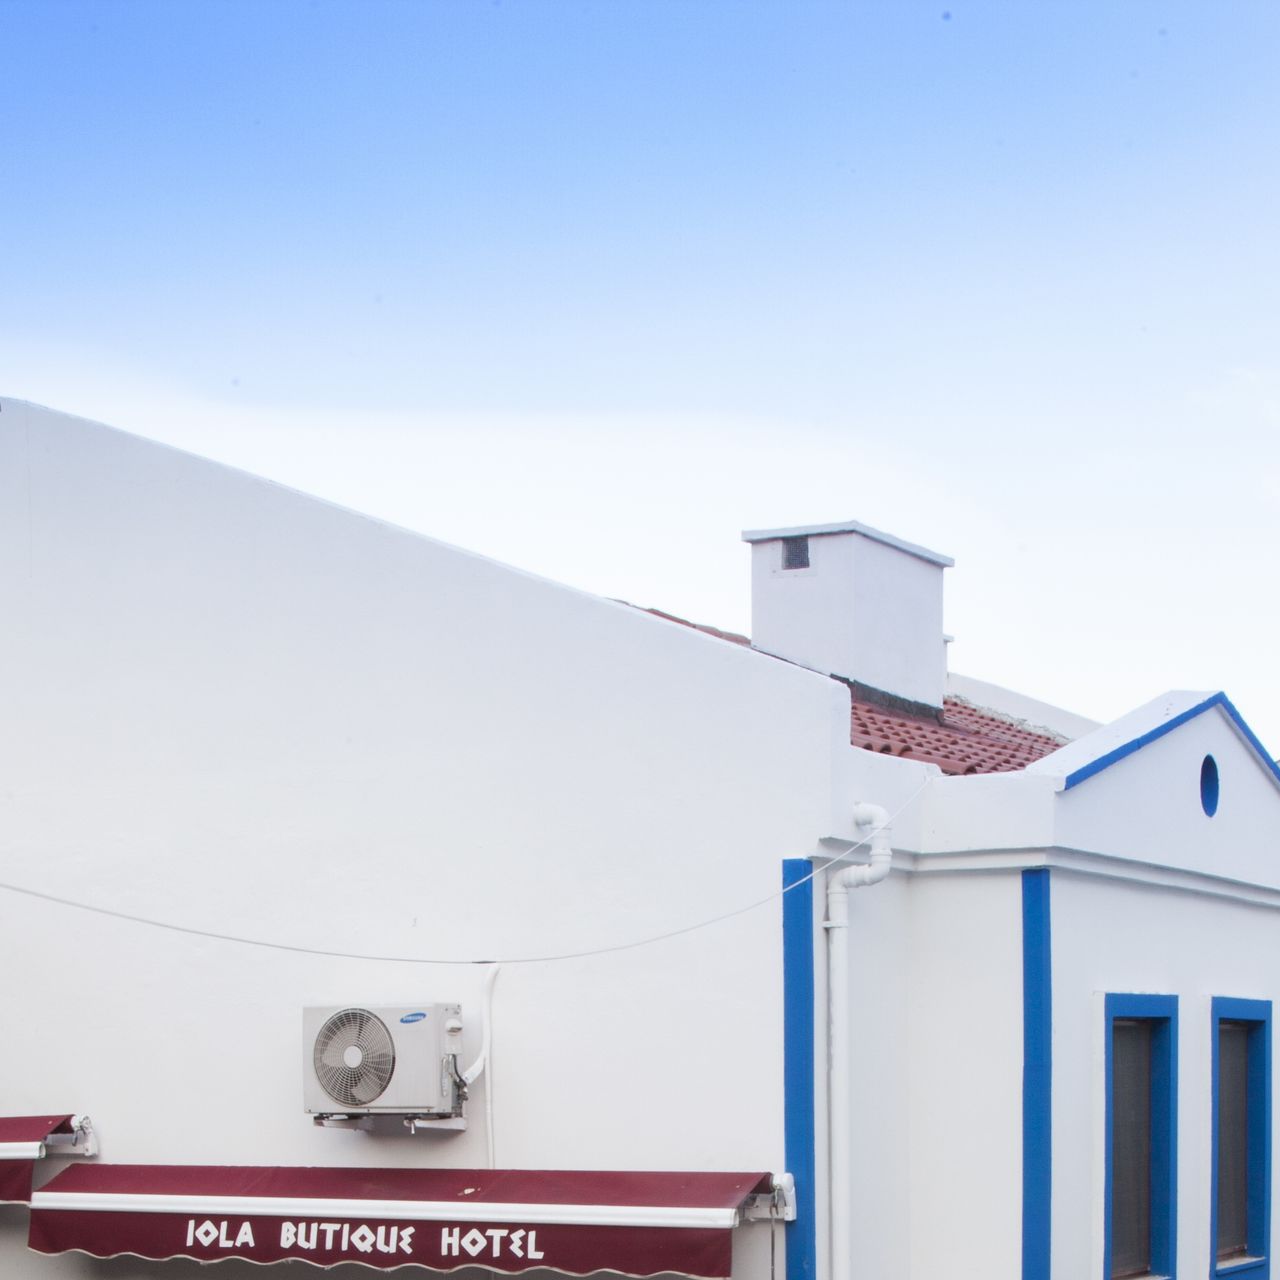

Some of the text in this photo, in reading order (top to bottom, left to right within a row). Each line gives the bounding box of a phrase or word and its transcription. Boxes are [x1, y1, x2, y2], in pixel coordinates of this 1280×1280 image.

[186, 1219, 545, 1260] IOLA BUTIQUE HOTEL
